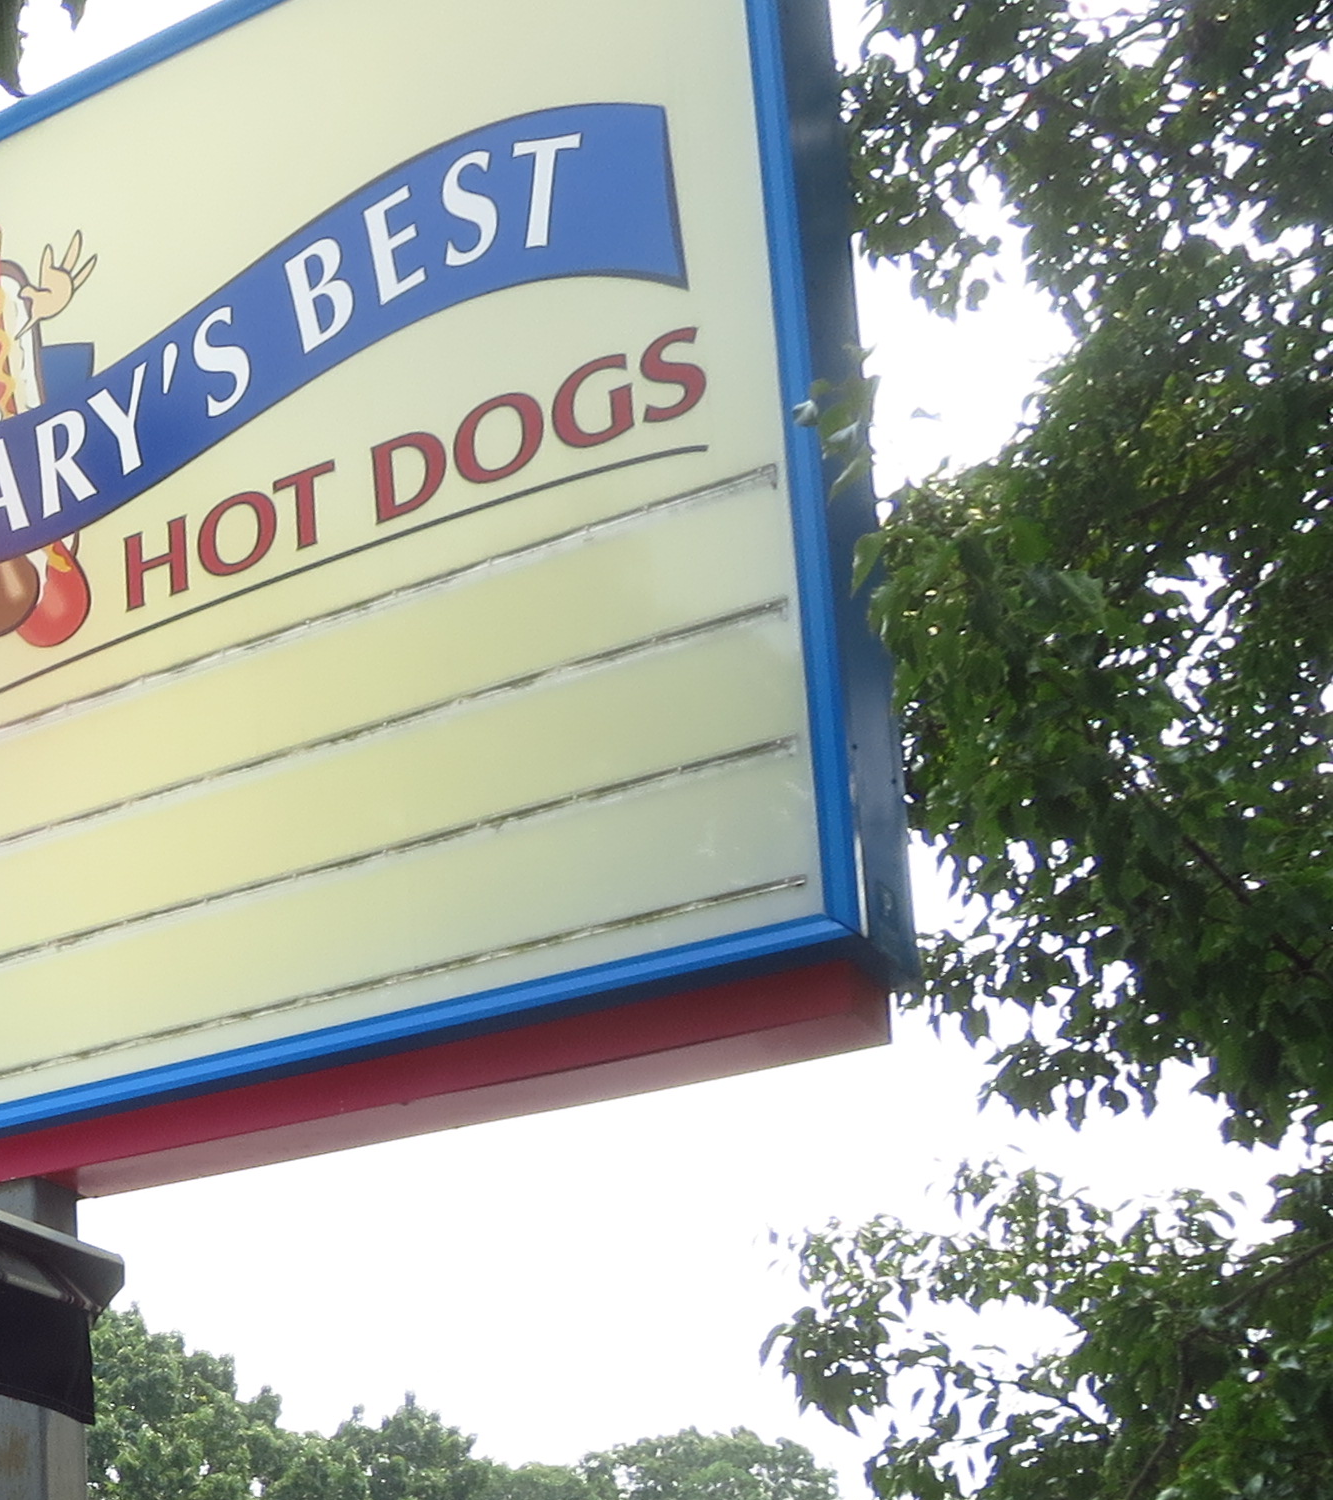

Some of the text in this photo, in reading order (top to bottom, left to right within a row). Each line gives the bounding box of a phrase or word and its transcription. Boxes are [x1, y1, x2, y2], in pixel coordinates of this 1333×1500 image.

[283, 132, 583, 356] BEST
[123, 325, 709, 612] HOT DOGS
